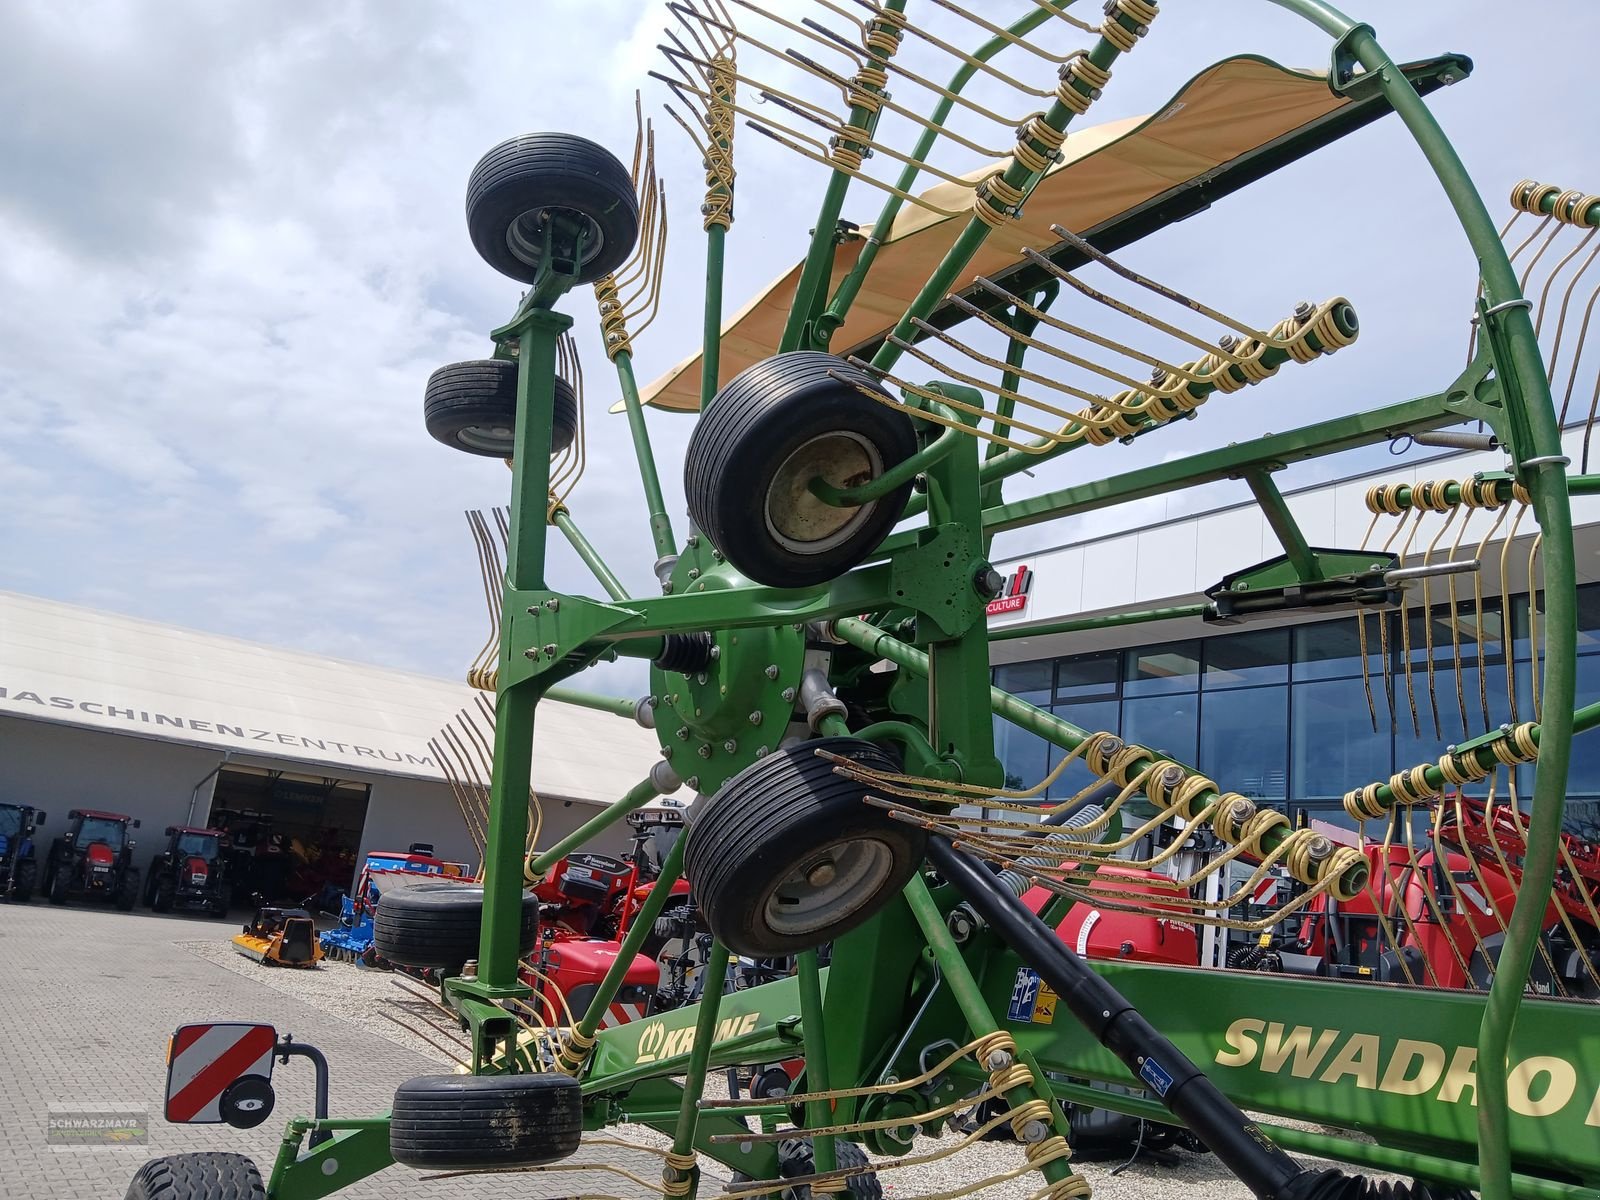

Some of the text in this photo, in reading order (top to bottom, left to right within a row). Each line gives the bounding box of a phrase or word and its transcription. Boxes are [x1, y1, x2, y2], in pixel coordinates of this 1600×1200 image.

[987, 599, 1021, 612] CULTURE
[0, 687, 435, 767] ASCHINENZENTRUM
[658, 1012, 760, 1061] KRNE
[1214, 1017, 1577, 1117] SWADRO
